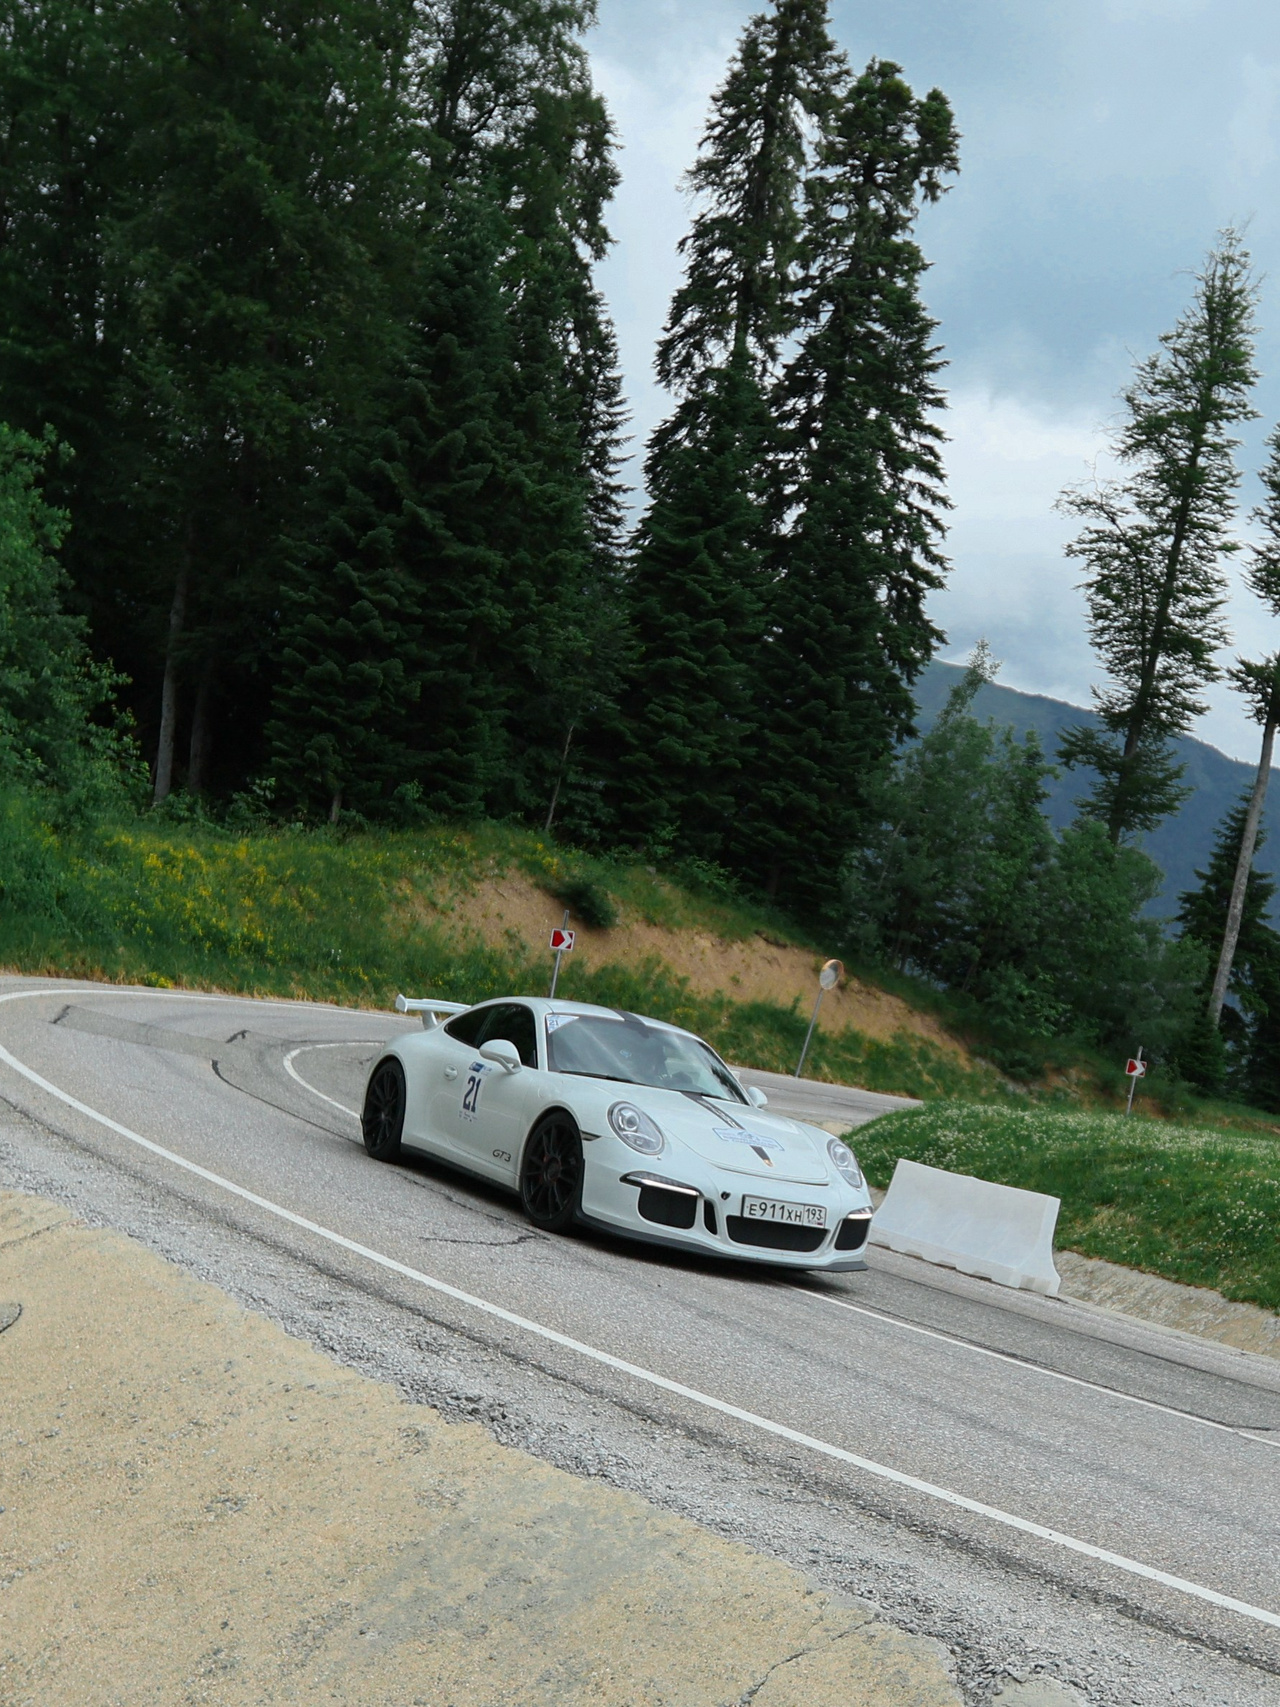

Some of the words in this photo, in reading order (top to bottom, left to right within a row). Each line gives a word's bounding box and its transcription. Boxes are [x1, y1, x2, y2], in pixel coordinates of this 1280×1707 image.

[462, 1075, 482, 1113] 21
[492, 1148, 512, 1163] GT3
[805, 1207, 823, 1221] 193
